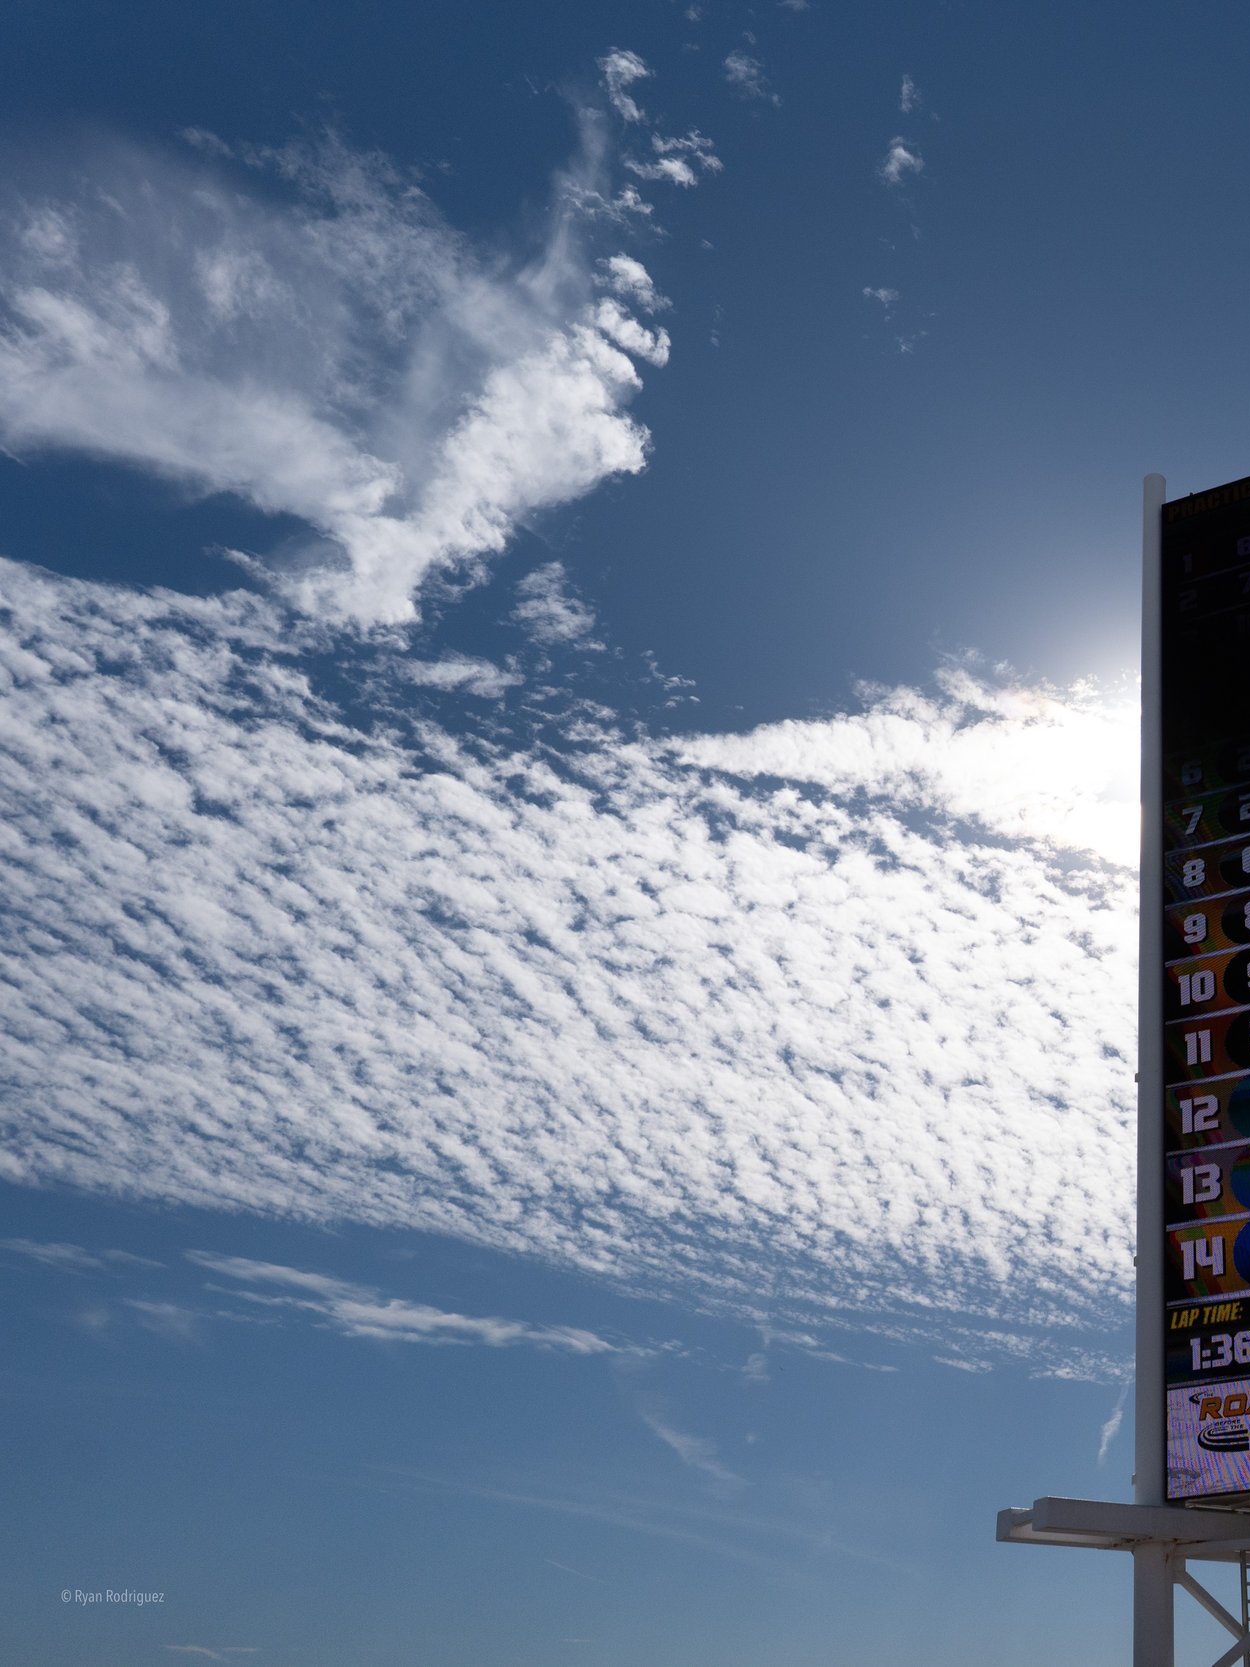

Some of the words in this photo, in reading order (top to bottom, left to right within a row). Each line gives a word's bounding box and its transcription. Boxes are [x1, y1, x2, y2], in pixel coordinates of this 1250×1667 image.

[1181, 759, 1202, 786] 6
[1182, 805, 1203, 835] 7
[1183, 858, 1206, 887] 8
[1183, 912, 1207, 944] 9
[1178, 969, 1215, 1006] 10
[1184, 1029, 1211, 1066] 11
[1179, 1094, 1219, 1134] 12
[1180, 1163, 1221, 1205] 13
[1180, 1235, 1223, 1280] 14
[1171, 1307, 1199, 1329] LAP
[1203, 1301, 1243, 1324] TIME:
